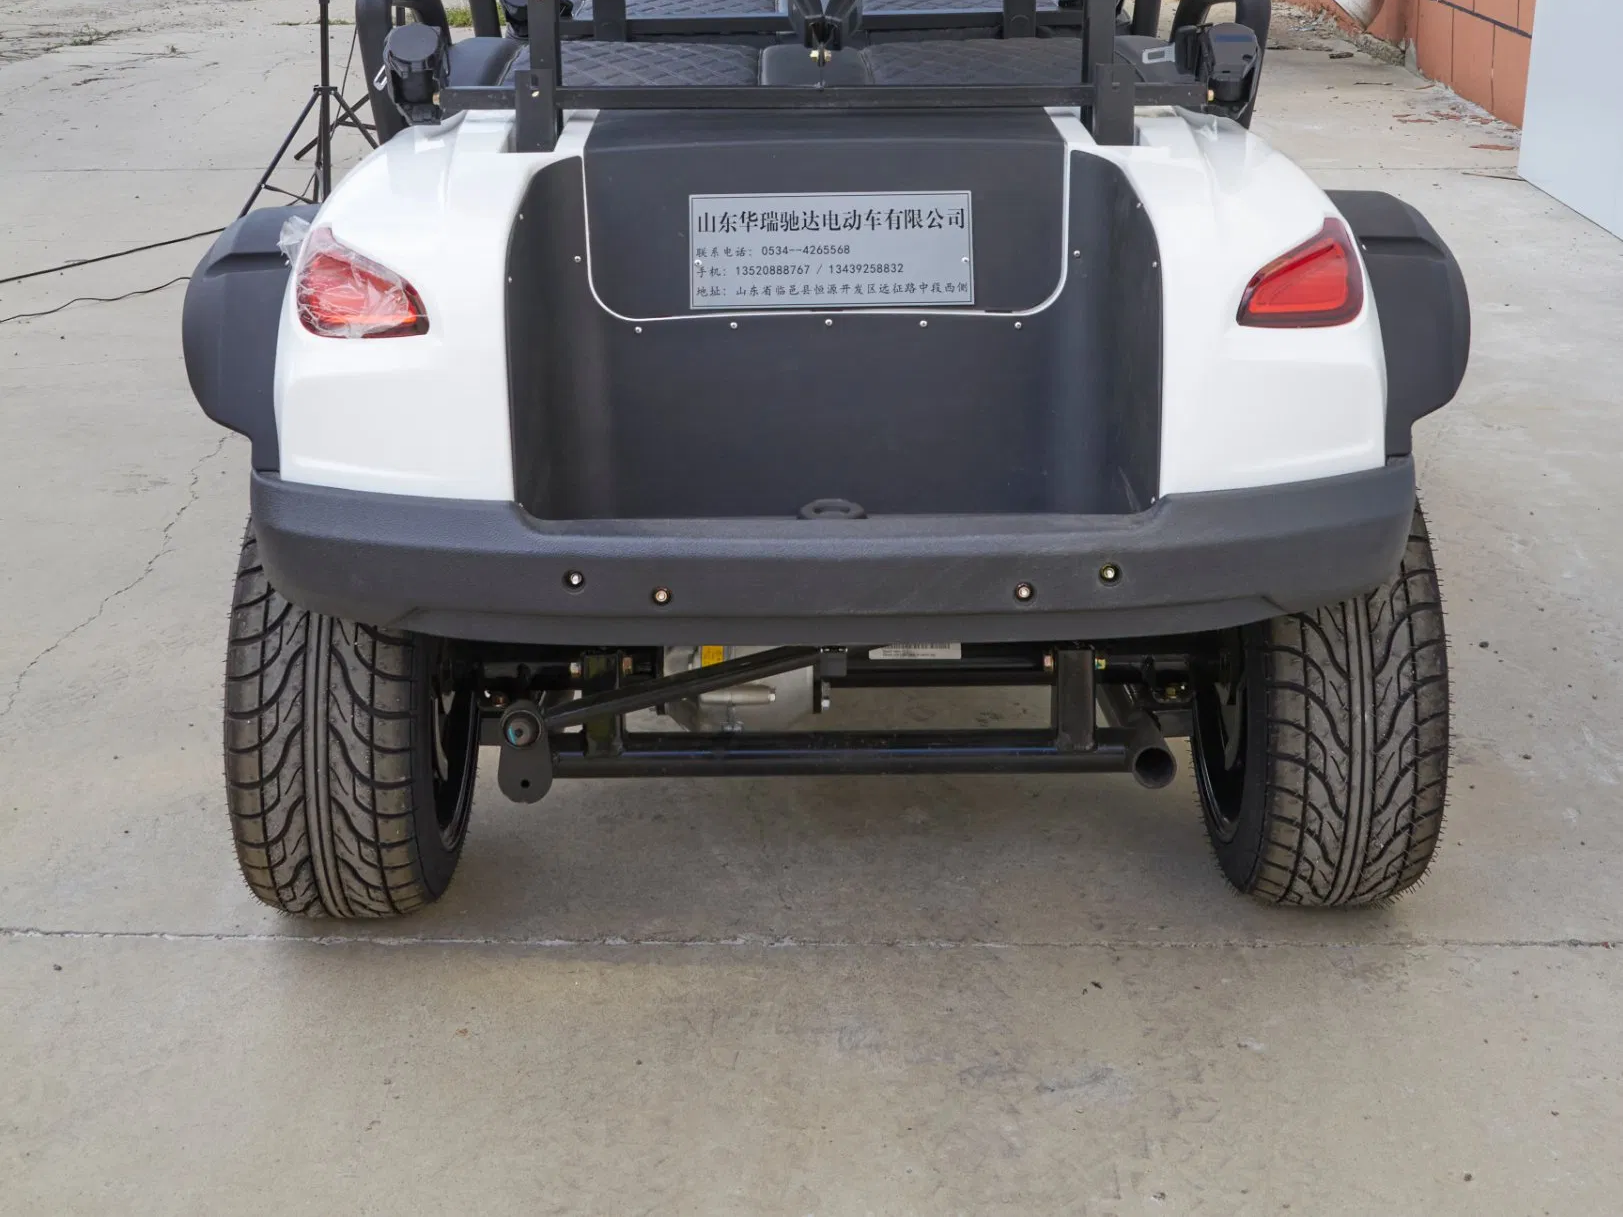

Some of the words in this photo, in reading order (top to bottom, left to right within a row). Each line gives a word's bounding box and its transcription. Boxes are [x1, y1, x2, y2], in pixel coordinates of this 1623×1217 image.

[698, 208, 965, 233] 山东华瑞驰达电动车有限公司
[736, 264, 810, 276] 13520888767
[829, 263, 904, 274] 13439258832
